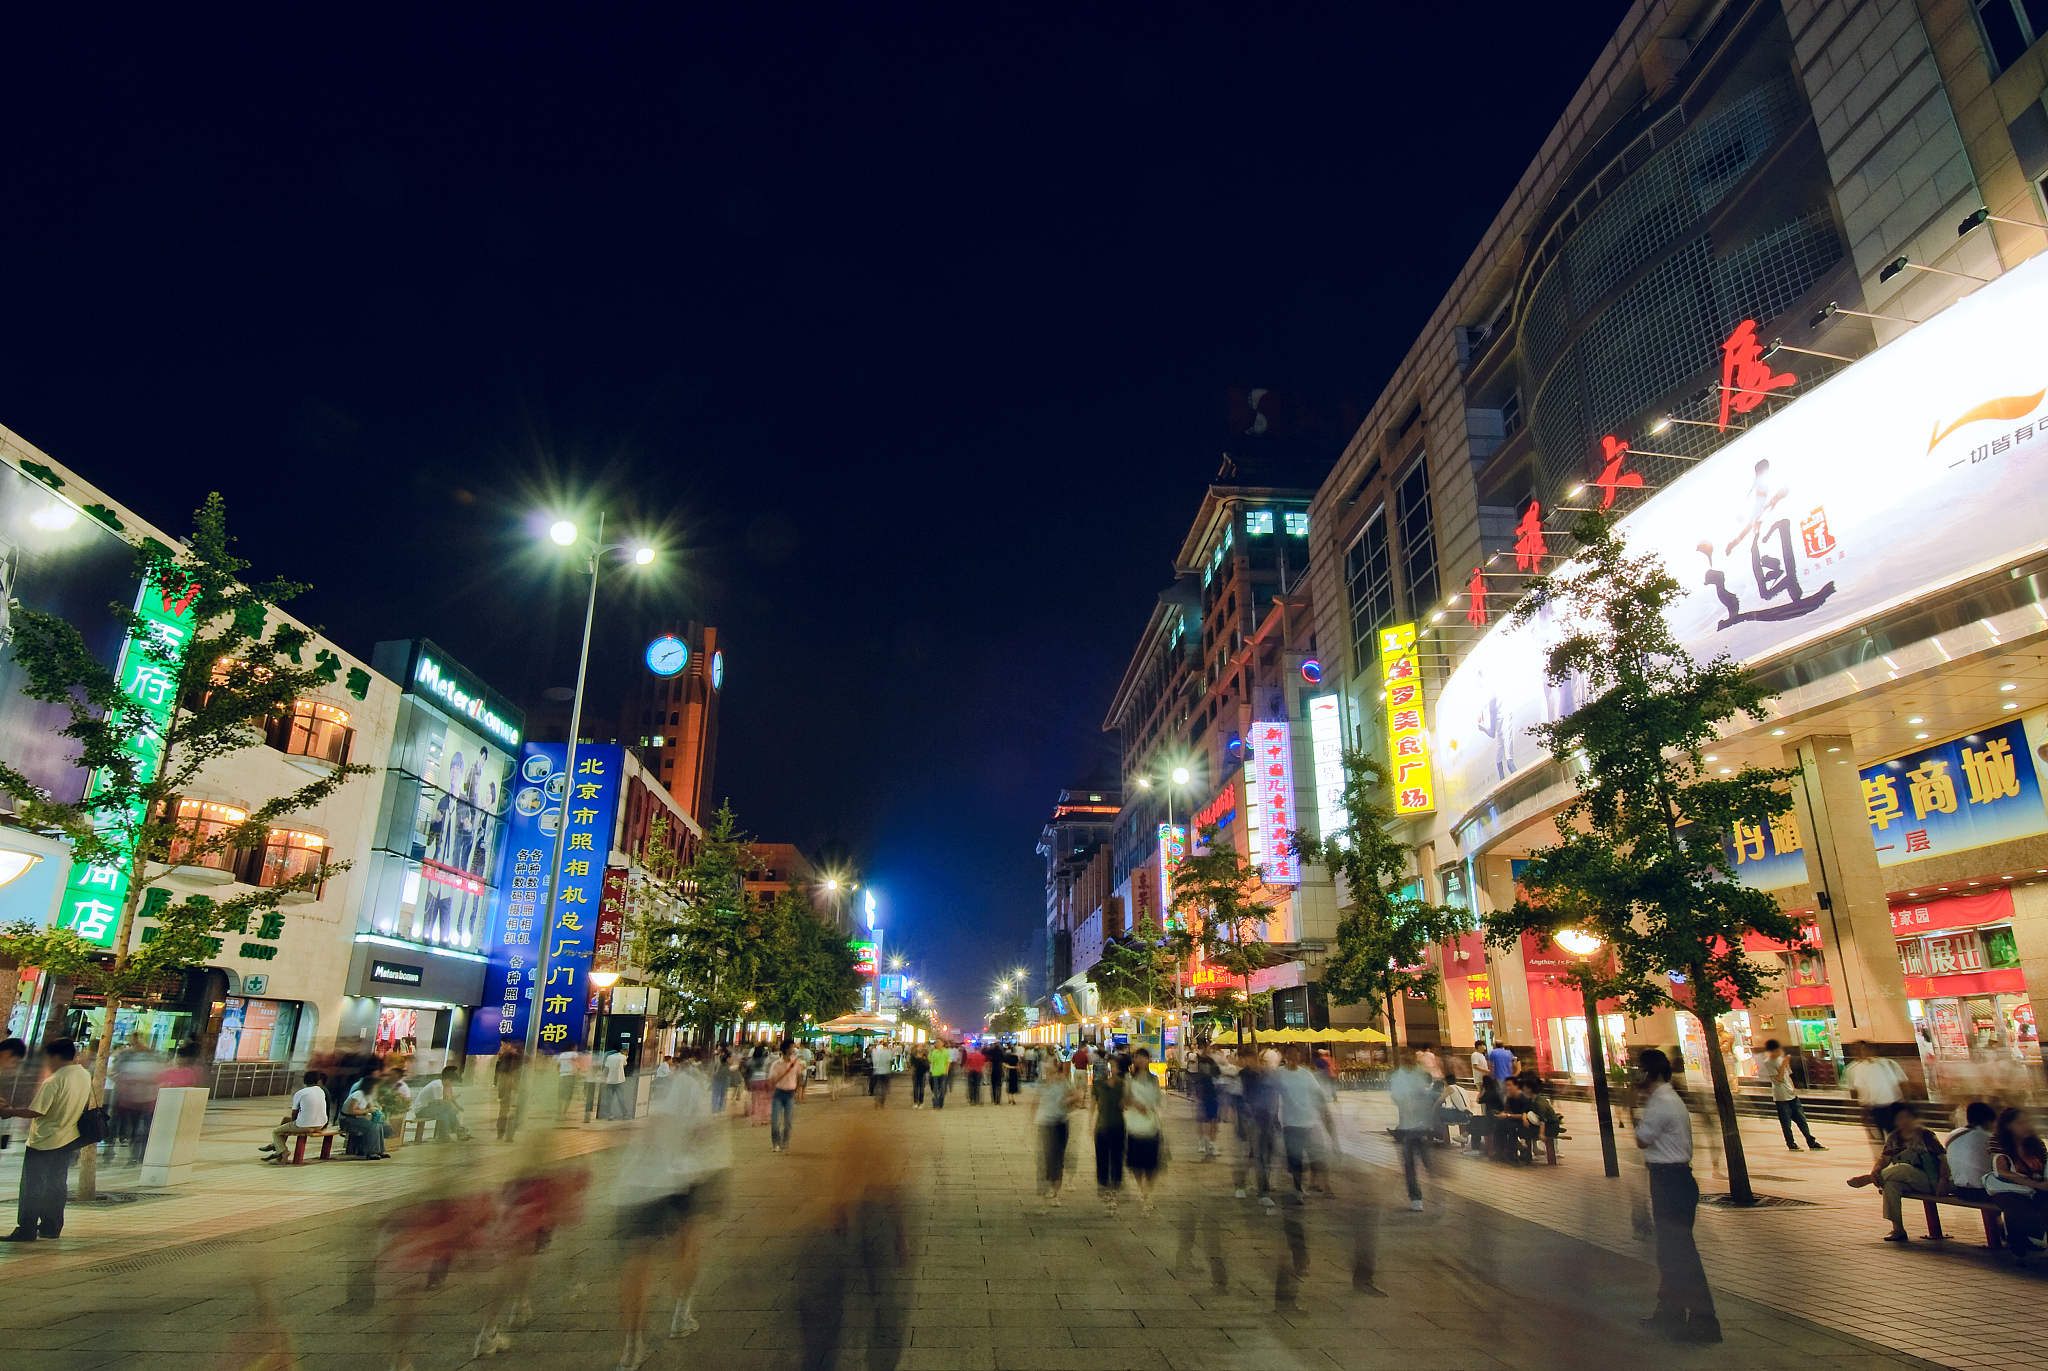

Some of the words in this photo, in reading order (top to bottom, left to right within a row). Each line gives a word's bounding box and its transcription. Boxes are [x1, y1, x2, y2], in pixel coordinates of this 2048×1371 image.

[517, 849, 543, 945] 各种数码照相机
[540, 758, 605, 1043] 北京市照相机总厂门市部
[239, 943, 278, 960] SHOP
[499, 955, 523, 1034] 各种照相机
